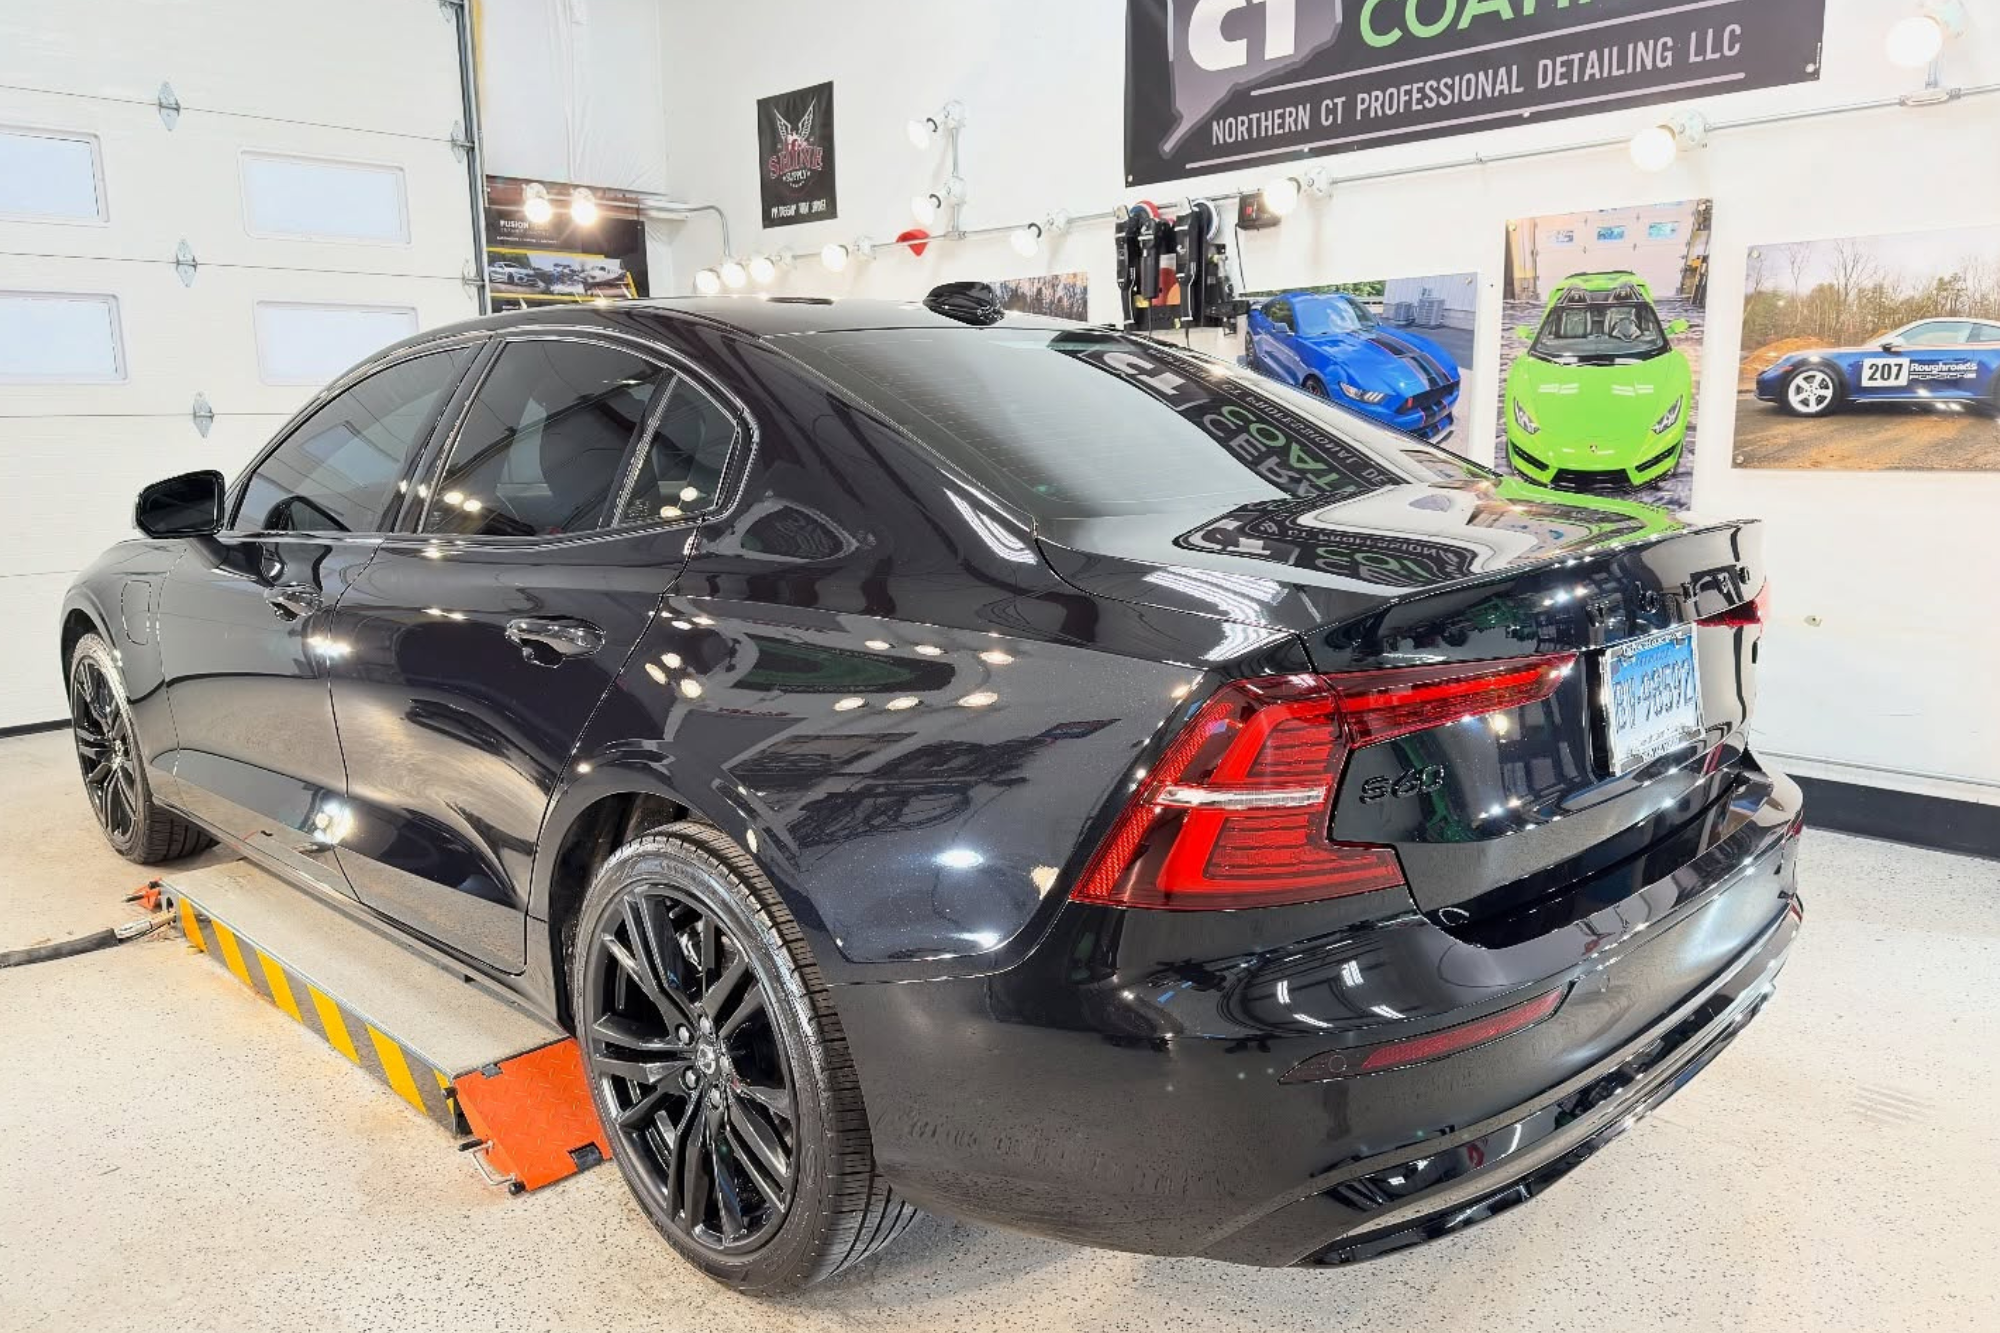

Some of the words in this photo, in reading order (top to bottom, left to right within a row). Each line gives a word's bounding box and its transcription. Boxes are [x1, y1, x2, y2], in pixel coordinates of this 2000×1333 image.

[1188, 0, 1296, 71] CT
[1212, 103, 1310, 146] NORTHERN
[1320, 97, 1347, 126] CT
[1356, 64, 1524, 121] PROFESSIONAL
[1537, 36, 1673, 90] DETAILING
[1688, 23, 1742, 63] LLC
[768, 146, 824, 180] SHINE
[499, 219, 529, 230] FUSION
[1866, 362, 1903, 382] 207
[1910, 361, 1978, 374] Roughroads
[1358, 764, 1446, 805] S60
